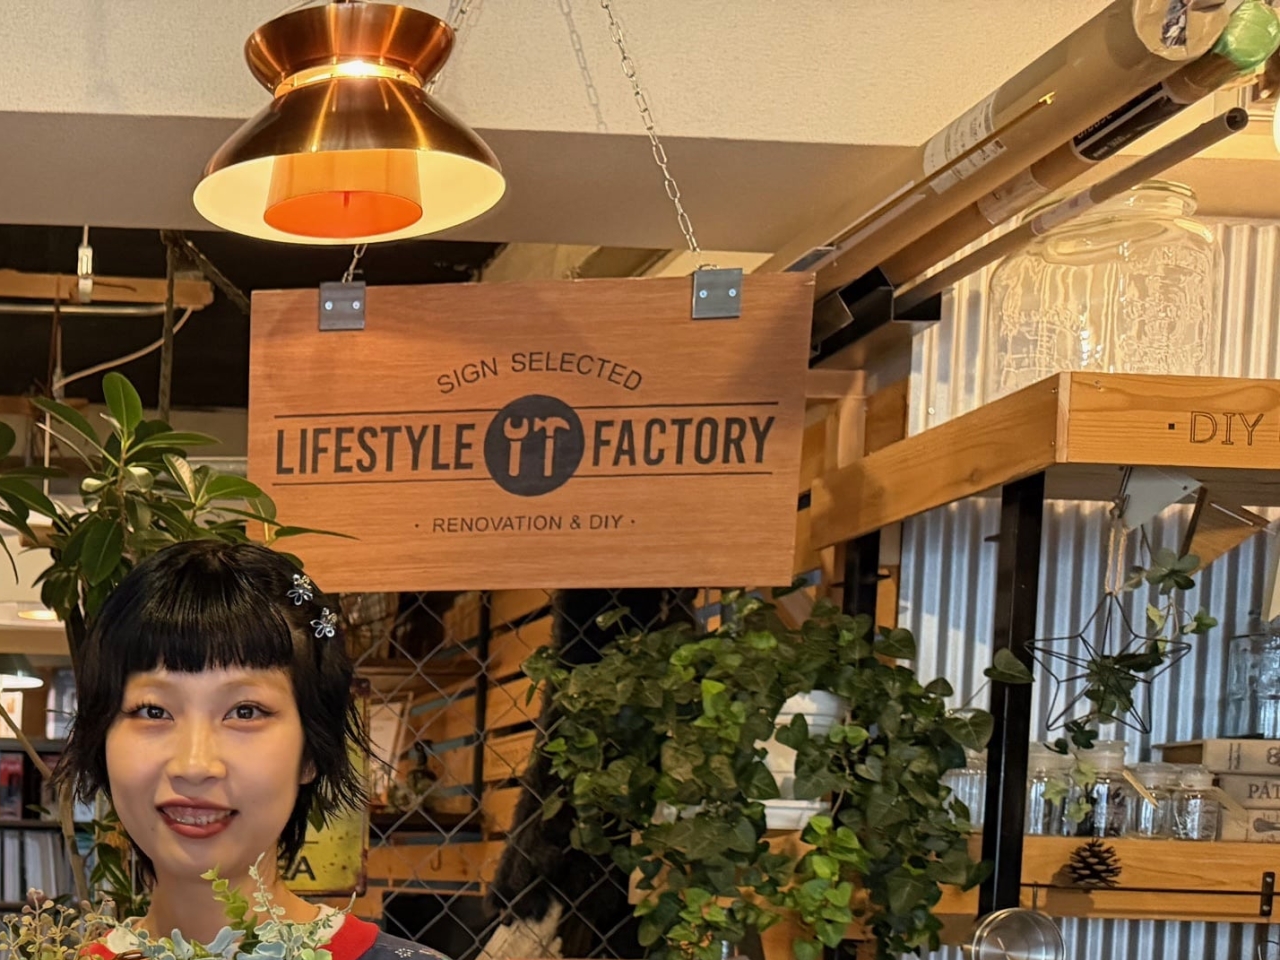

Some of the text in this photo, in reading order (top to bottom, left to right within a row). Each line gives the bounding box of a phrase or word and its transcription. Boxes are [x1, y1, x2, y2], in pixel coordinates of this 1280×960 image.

[437, 351, 643, 394] SIGN SELECTED
[276, 416, 775, 475] LIFESTYLE FACTORY
[1190, 411, 1264, 446] DIY
[432, 514, 624, 533] RENOVATION & DIY
